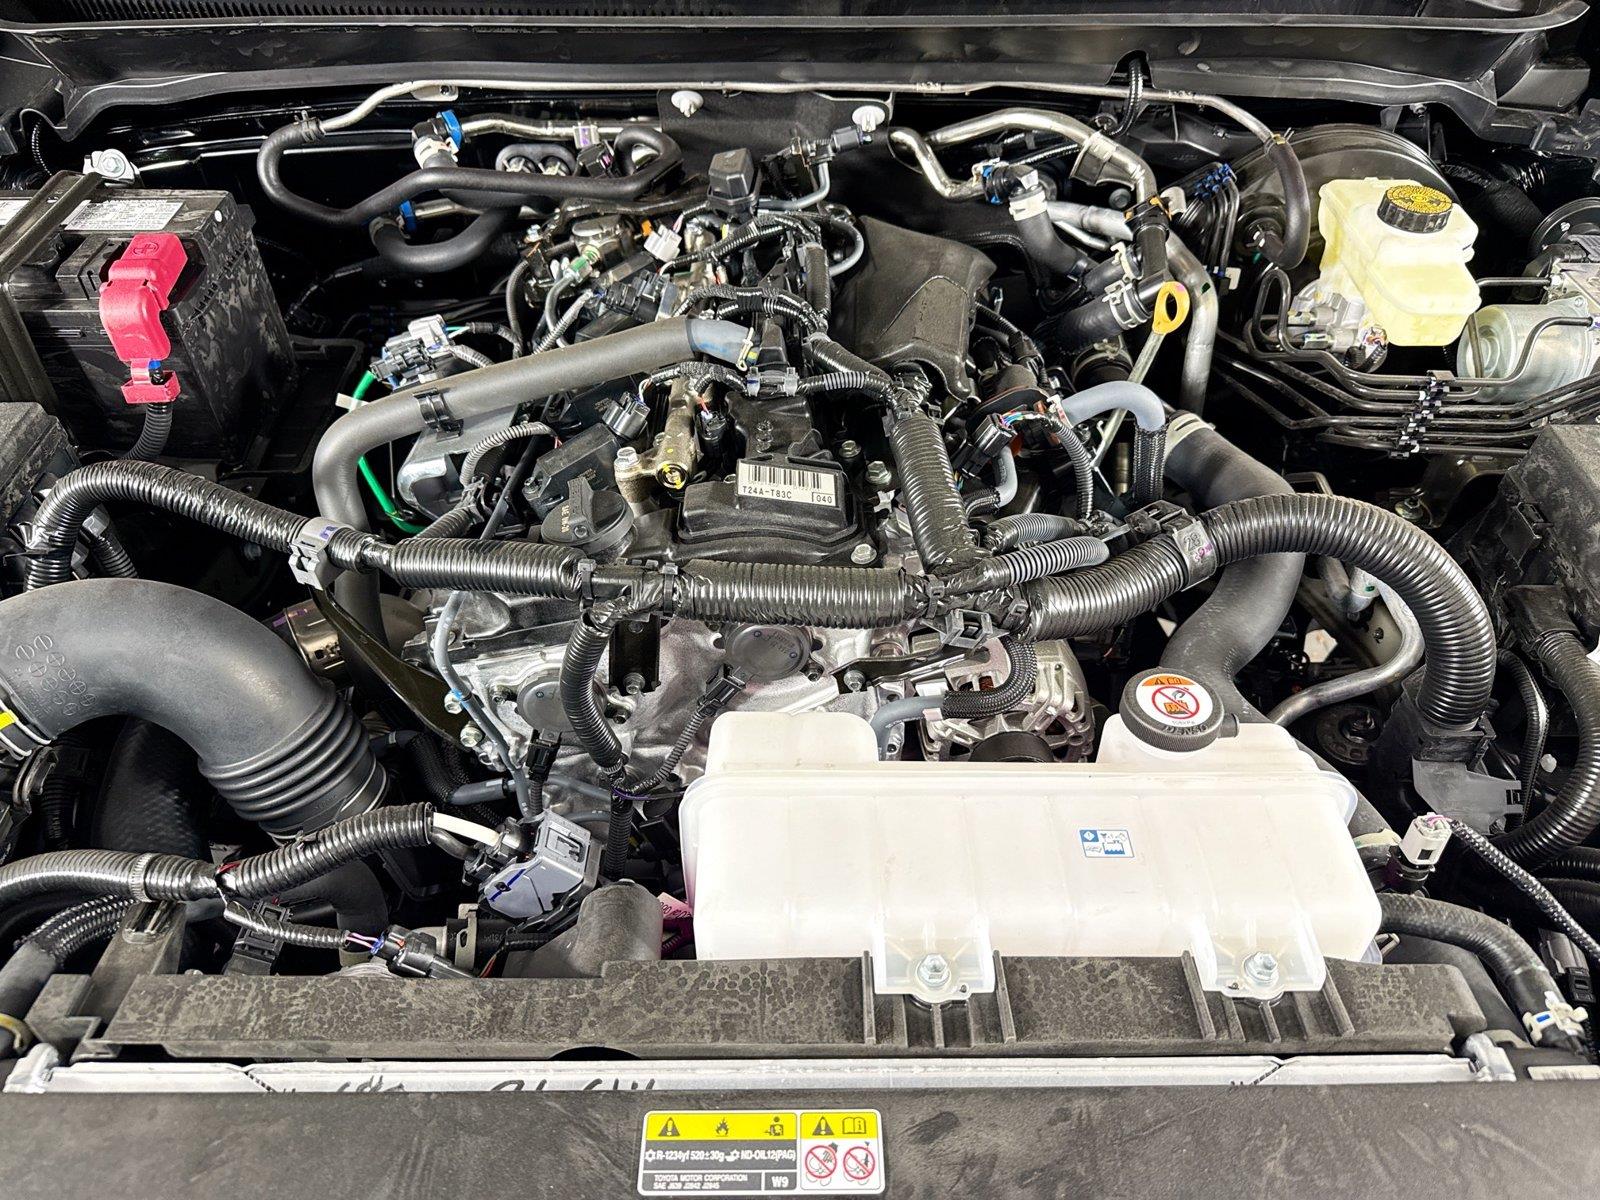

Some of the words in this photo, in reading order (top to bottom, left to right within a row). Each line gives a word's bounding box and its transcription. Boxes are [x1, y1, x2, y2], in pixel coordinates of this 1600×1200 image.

[743, 486, 792, 499] T24A-T83C
[816, 495, 833, 504] 040
[1162, 724, 1208, 736] DENSO
[656, 1150, 690, 1162] R-1234yf
[691, 1150, 725, 1162] 520±30g
[740, 1149, 796, 1161] ND-OIL12(PAG)
[654, 1174, 679, 1182] TOYOTA
[680, 1174, 703, 1182] MOTOR
[703, 1174, 748, 1182] CORPORATION
[771, 1175, 789, 1188] W9
[653, 1182, 667, 1190] SAE
